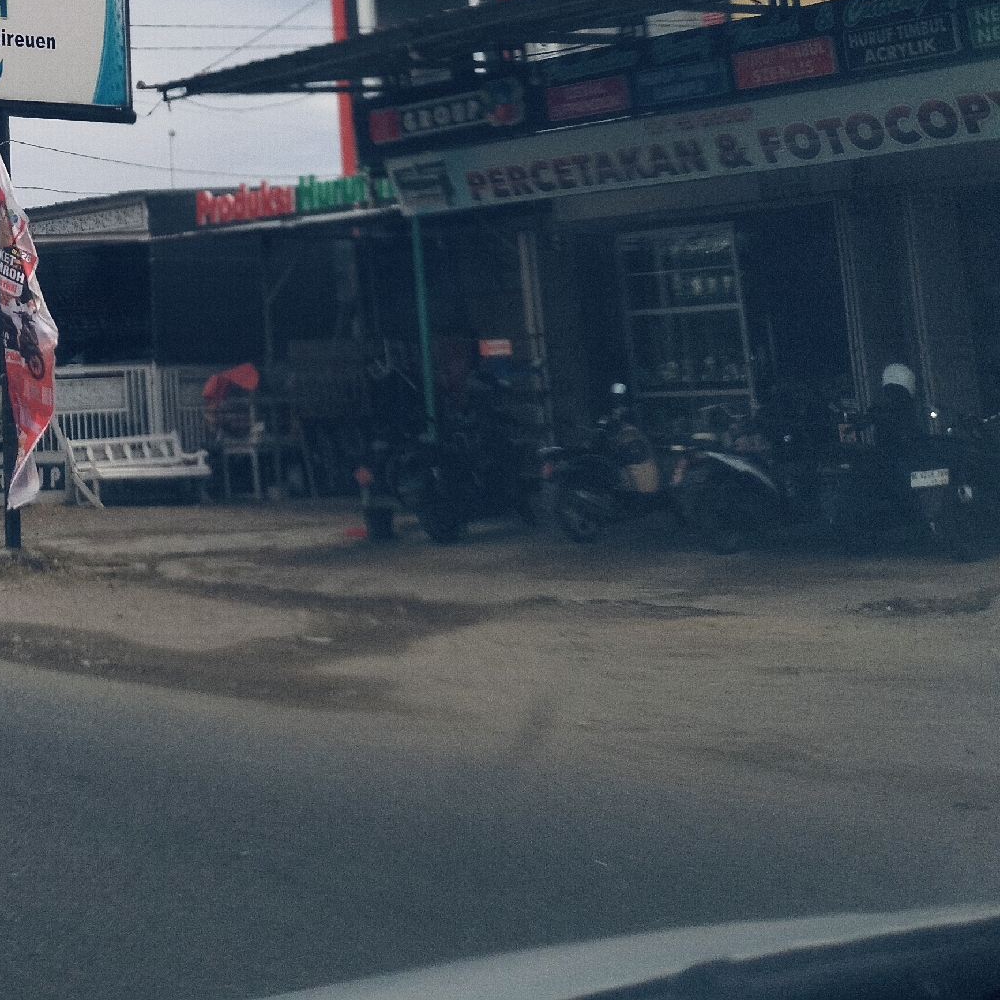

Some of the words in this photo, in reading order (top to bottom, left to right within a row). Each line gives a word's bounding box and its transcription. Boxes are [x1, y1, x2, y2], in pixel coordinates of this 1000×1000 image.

[849, 28, 893, 49] HURUF
[894, 17, 948, 42] TIMBUL
[864, 38, 937, 64] ACRYLIK
[403, 99, 480, 132] GROUP
[465, 138, 709, 201] PERCETAKAN
[716, 132, 753, 169] &
